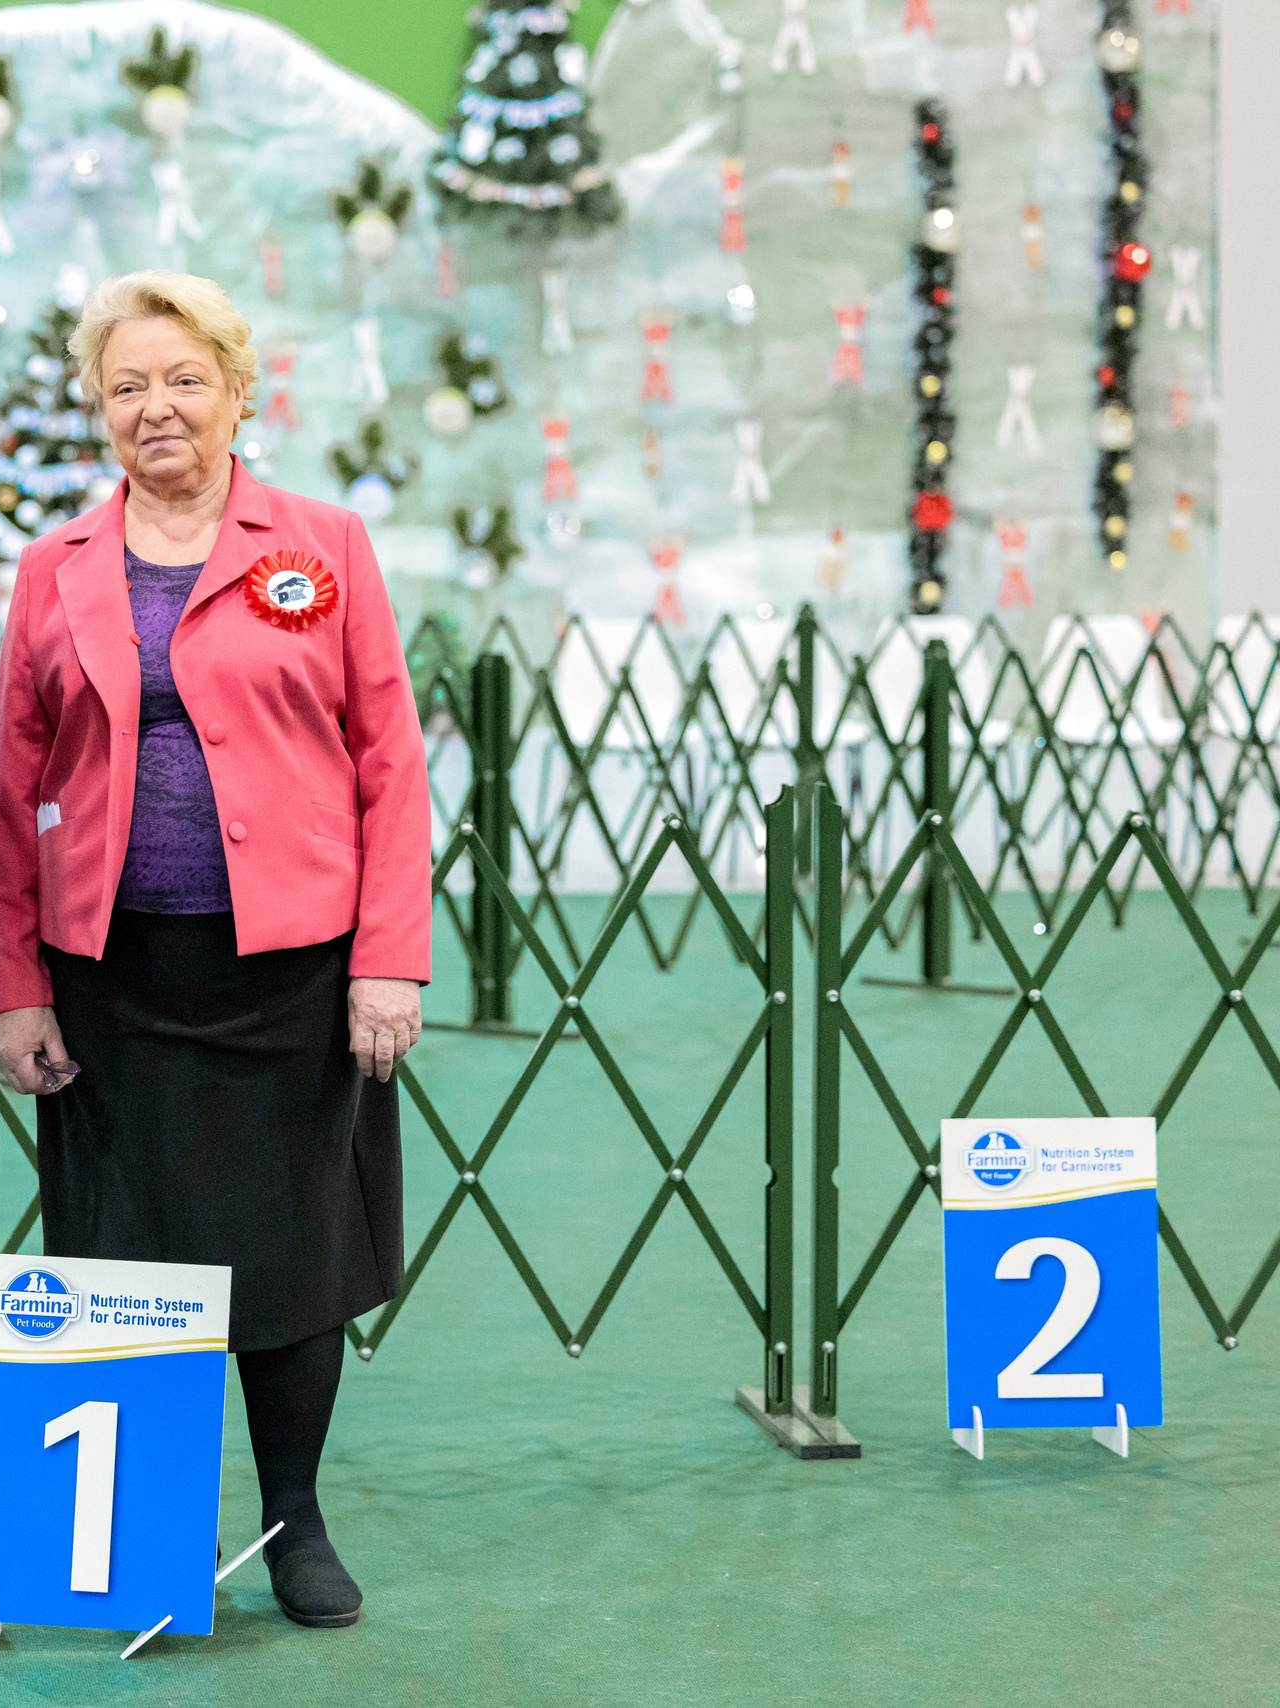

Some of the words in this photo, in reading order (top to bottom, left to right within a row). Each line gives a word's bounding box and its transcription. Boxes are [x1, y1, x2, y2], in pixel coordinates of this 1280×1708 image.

[967, 1152, 1026, 1166] Farmina
[1041, 1147, 1090, 1158] Nutrition
[1094, 1147, 1134, 1160] System
[1042, 1161, 1057, 1172] for
[1061, 1161, 1122, 1172] Carnivores
[0, 1293, 73, 1315] Farmina
[90, 1293, 149, 1310] Nutrition
[154, 1297, 204, 1314] System
[16, 1318, 29, 1328] Pet
[31, 1319, 55, 1329] Foods
[90, 1310, 109, 1324] for
[113, 1311, 187, 1329] Carnivores
[995, 1237, 1104, 1399] 2
[43, 1400, 119, 1594] 1
